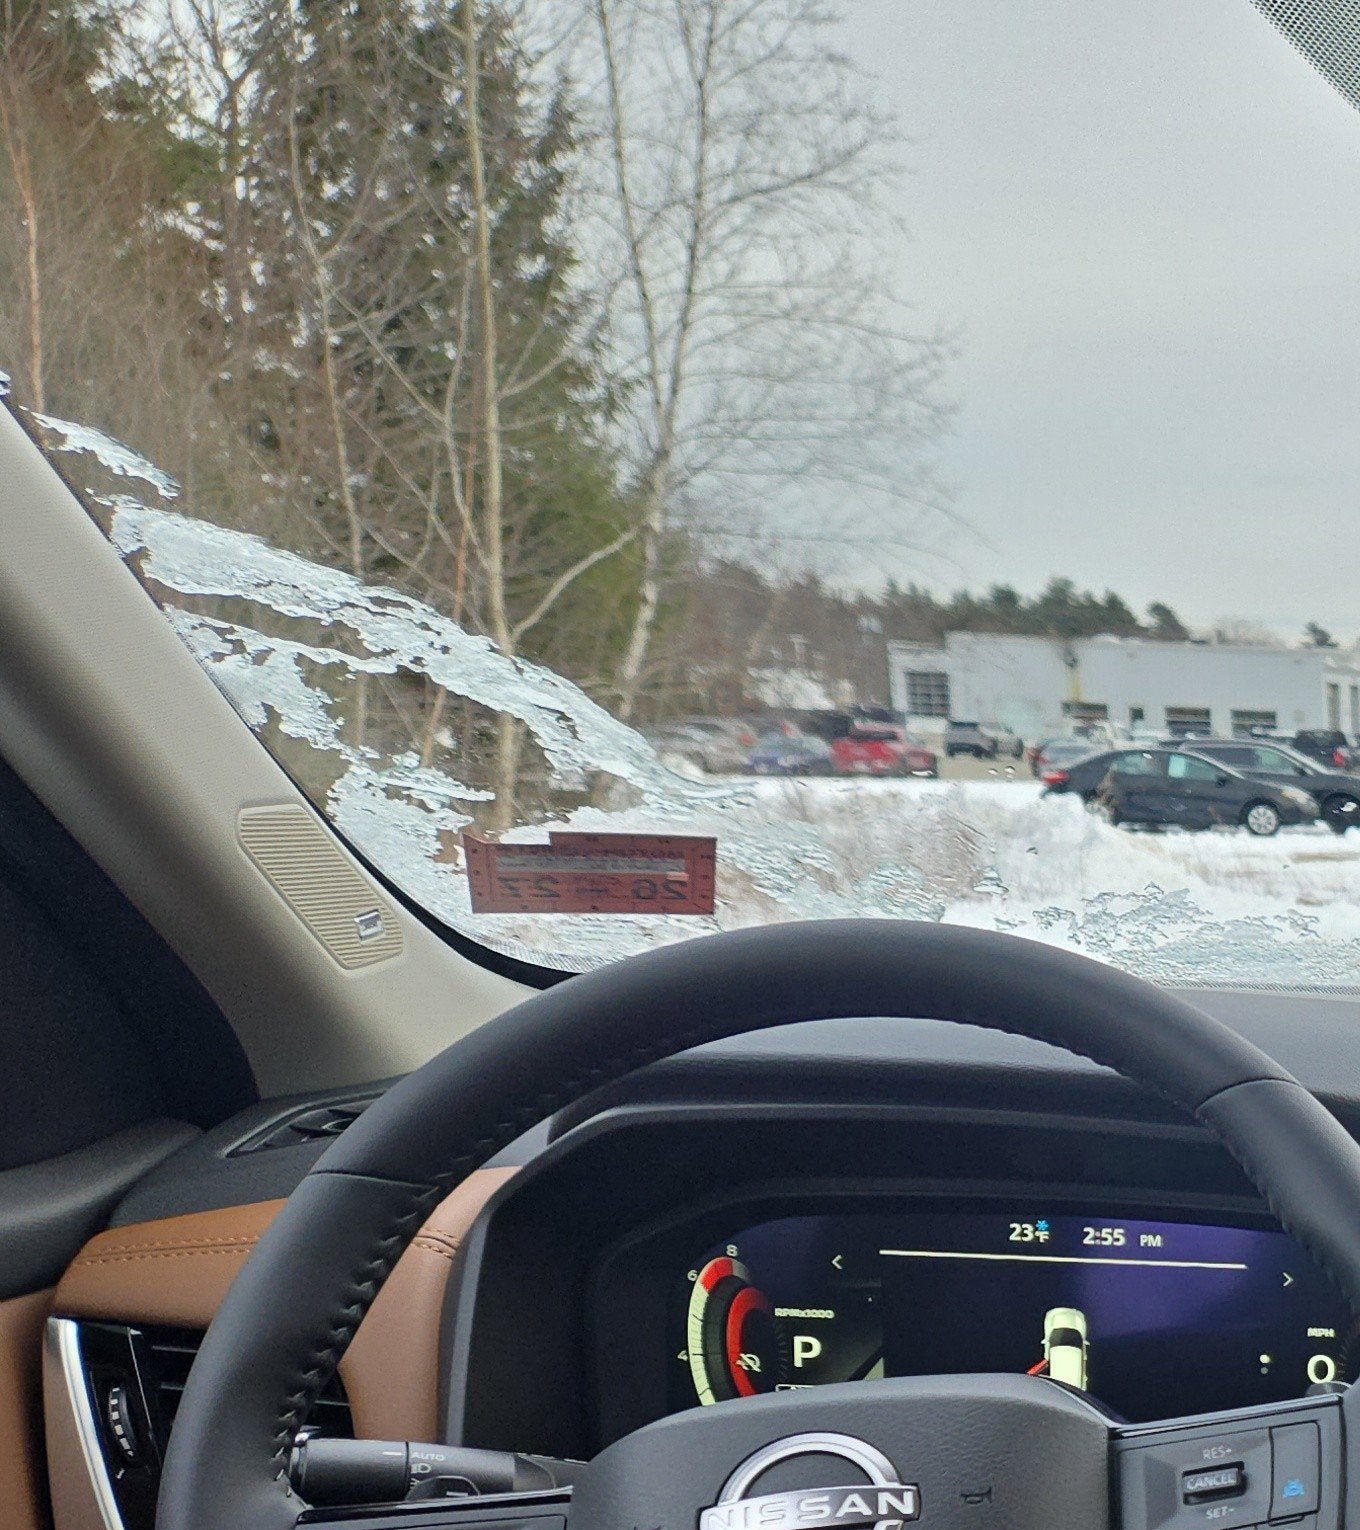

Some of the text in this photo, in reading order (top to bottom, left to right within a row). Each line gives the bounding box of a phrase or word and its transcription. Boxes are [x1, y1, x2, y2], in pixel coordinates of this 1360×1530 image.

[1083, 1227, 1125, 1246] 2:55
[1140, 1235, 1162, 1248] PM
[726, 1244, 738, 1257] 8
[687, 1269, 698, 1281] 6
[1307, 1327, 1335, 1338] MPH
[793, 1335, 822, 1368] P
[411, 1452, 446, 1462] AUTO
[1186, 1470, 1236, 1490] CANCEL
